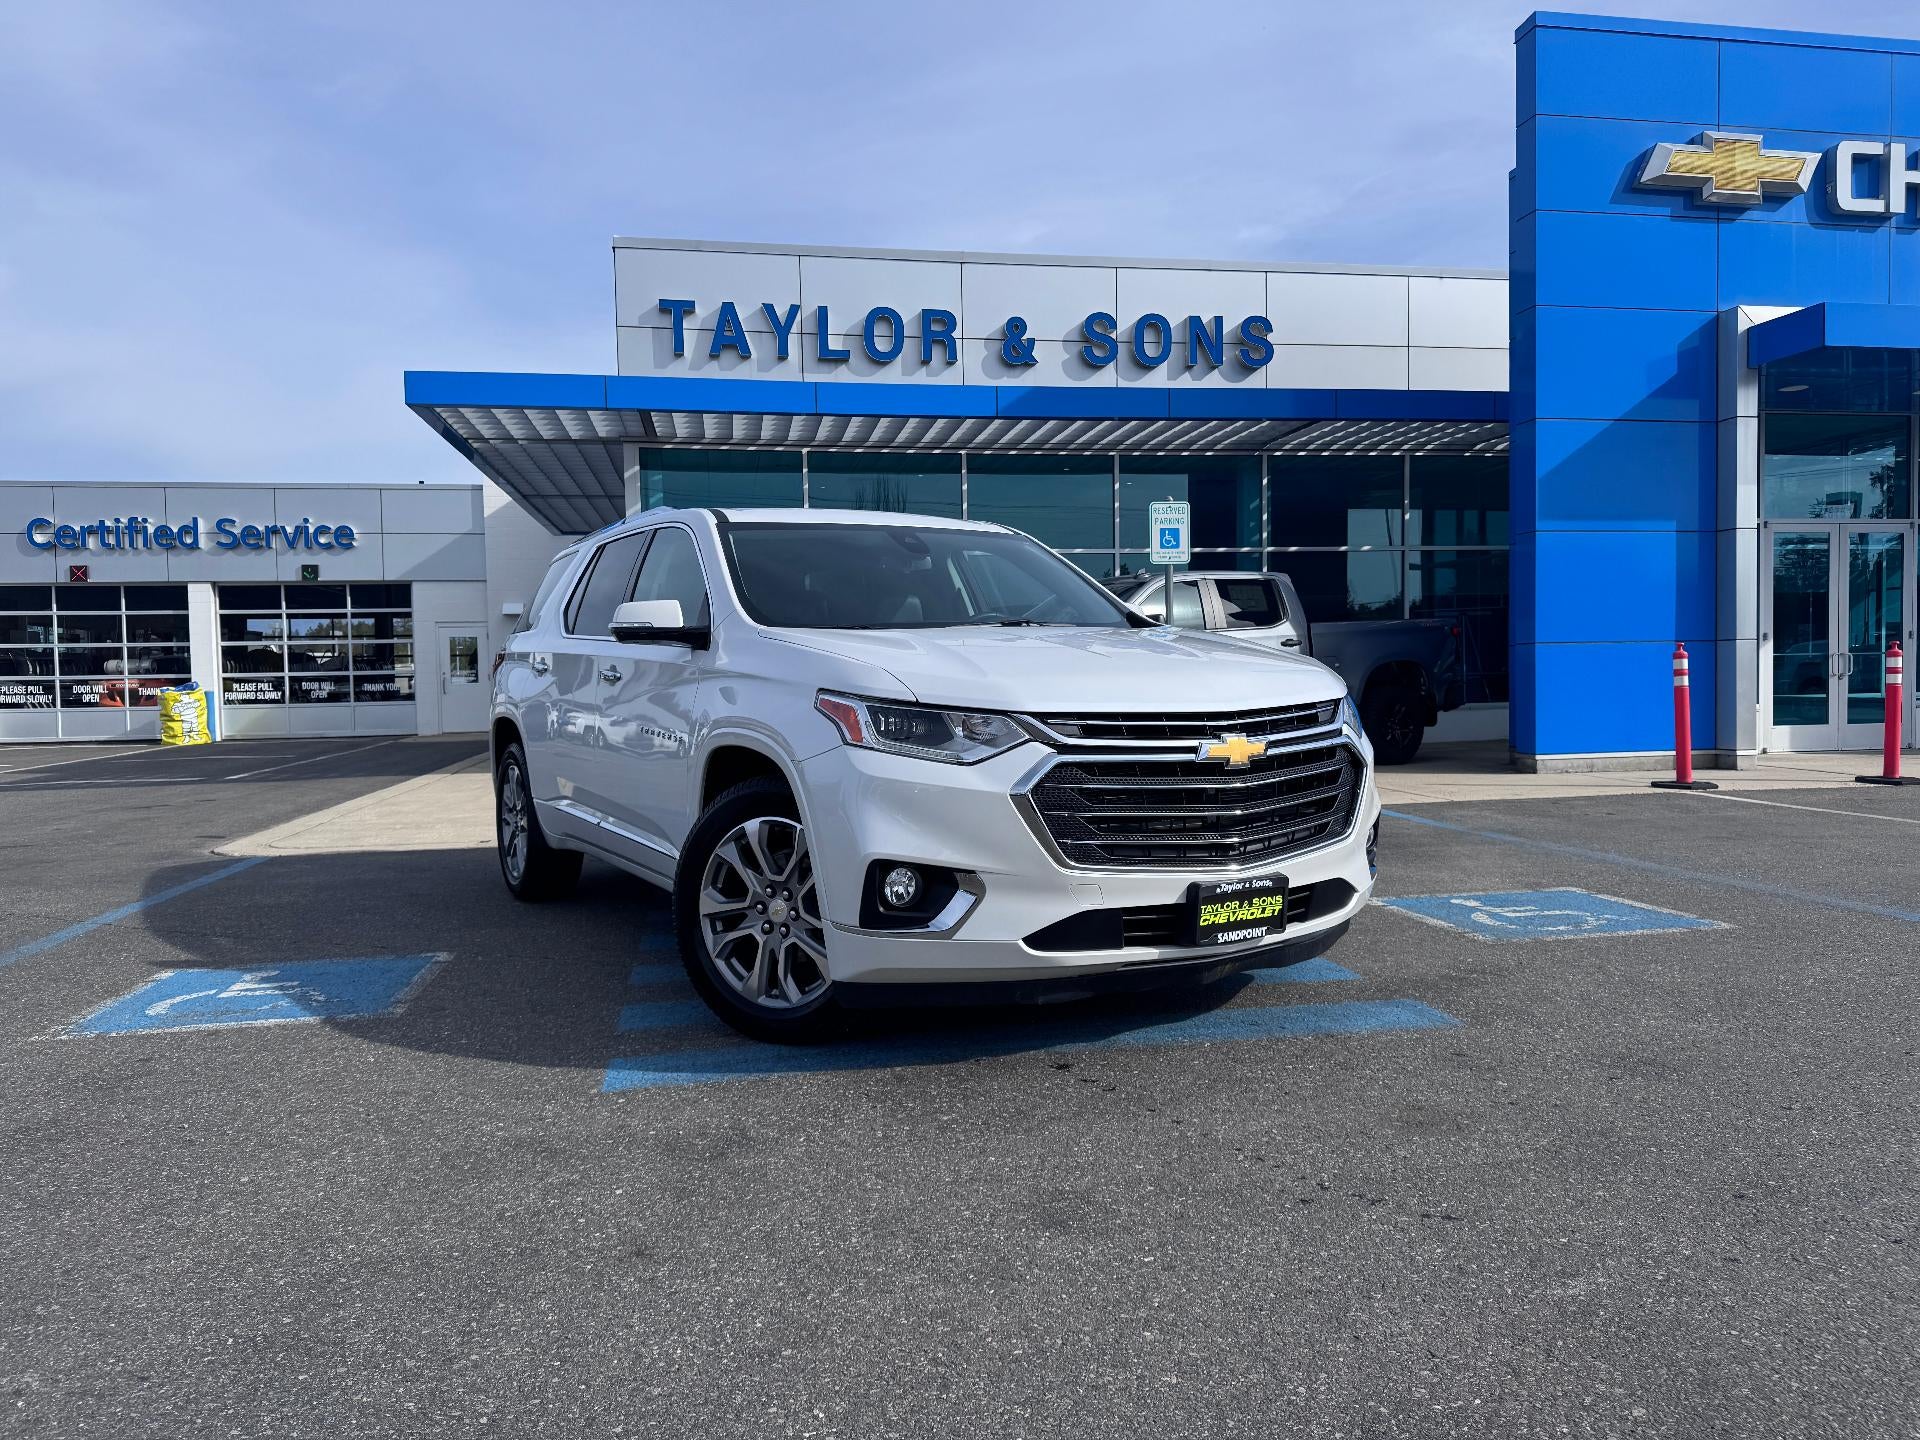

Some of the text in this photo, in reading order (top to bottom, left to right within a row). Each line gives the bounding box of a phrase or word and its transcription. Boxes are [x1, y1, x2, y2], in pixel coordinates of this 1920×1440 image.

[1834, 140, 1920, 213] CH
[658, 298, 1275, 371] TAYLOR & SONS
[1153, 506, 1186, 515] RESERVED
[1154, 517, 1185, 525] PARKING
[26, 517, 356, 550] Certified Service
[1, 685, 45, 695] PLEASE PULL
[73, 685, 92, 694] DOOR
[92, 684, 109, 694] WILL
[233, 682, 274, 692] PLEASE PULL
[301, 681, 336, 690] DOOR WILL
[363, 682, 385, 692] THANK
[27, 694, 53, 703] SLOWLY
[82, 694, 100, 703] OPEN
[224, 691, 282, 701] FORWARD SLOWLY
[310, 690, 328, 699] OPEN
[1220, 882, 1244, 893] Taylor
[1201, 895, 1283, 913] TAYLOR & SONS
[1200, 907, 1282, 926] CHEVROLET
[1217, 927, 1267, 943] SANDPOINT
